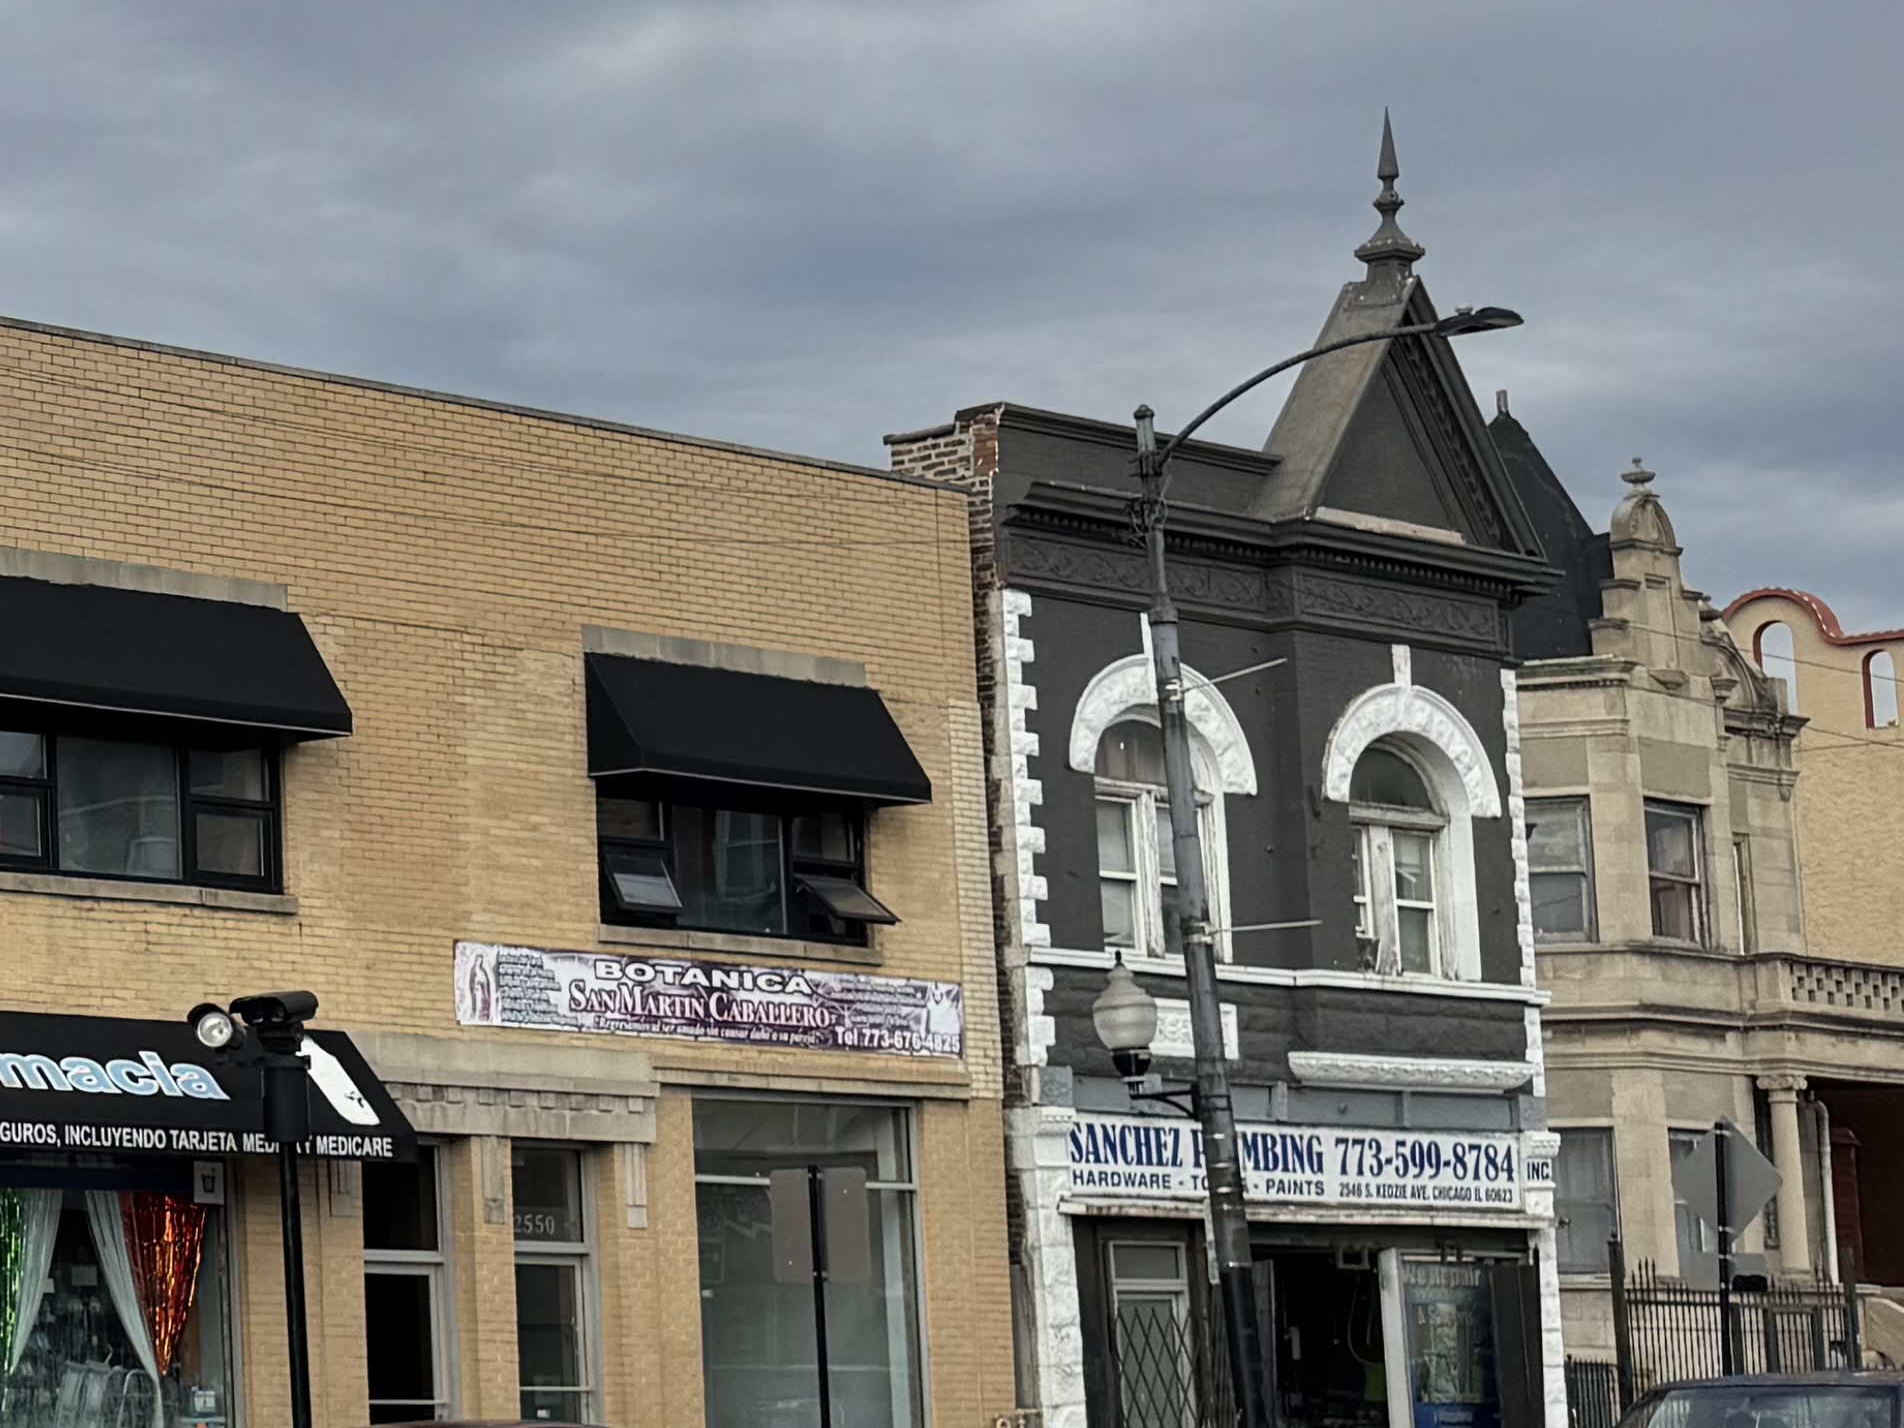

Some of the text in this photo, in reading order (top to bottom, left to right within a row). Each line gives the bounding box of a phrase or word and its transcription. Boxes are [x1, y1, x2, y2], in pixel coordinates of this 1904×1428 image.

[595, 959, 813, 995] BOTANICA
[569, 979, 615, 1013] SAN
[709, 992, 831, 1028] CABALLERO
[65, 1125, 166, 1150] INCLUYENDO
[169, 1130, 237, 1152] TARJETA
[316, 1135, 393, 1157] MEDICARE
[1070, 1122, 1183, 1169] SANCHEZ
[1335, 1136, 1515, 1181] 773-599-8784
[1072, 1170, 1172, 1190] HARDWARE
[1527, 1161, 1550, 1181] INC
[1266, 1178, 1325, 1196] PAINTS
[1376, 1184, 1407, 1199] KEDZIE
[1432, 1185, 1471, 1202] CHICAGO
[1475, 1187, 1483, 1202] IL
